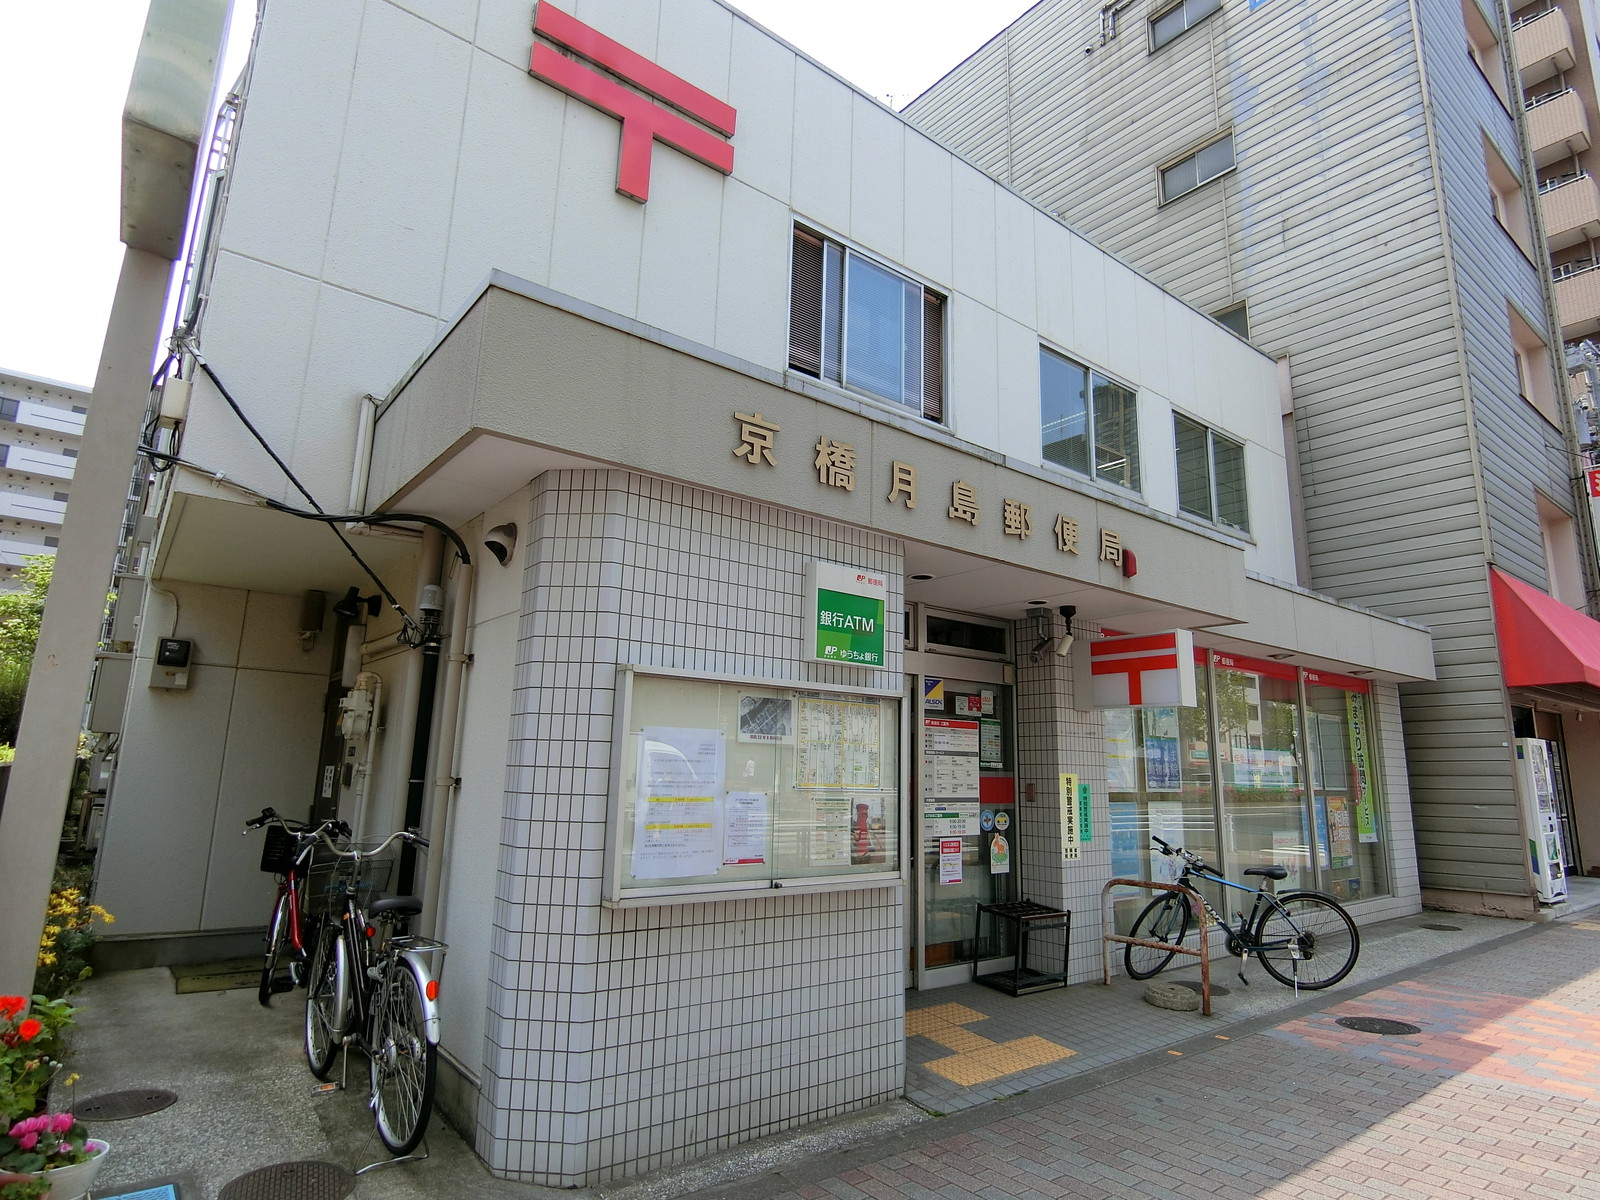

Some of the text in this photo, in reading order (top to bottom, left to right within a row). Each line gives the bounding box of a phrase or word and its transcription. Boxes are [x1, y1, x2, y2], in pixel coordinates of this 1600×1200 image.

[732, 411, 1124, 568] 京橋月島郵便局
[867, 578, 883, 587] 郵便局
[819, 610, 874, 633] 銀行ATM
[824, 645, 878, 662] JP ゆうちょ銀行
[1065, 776, 1074, 845] 特別警戒実施中
